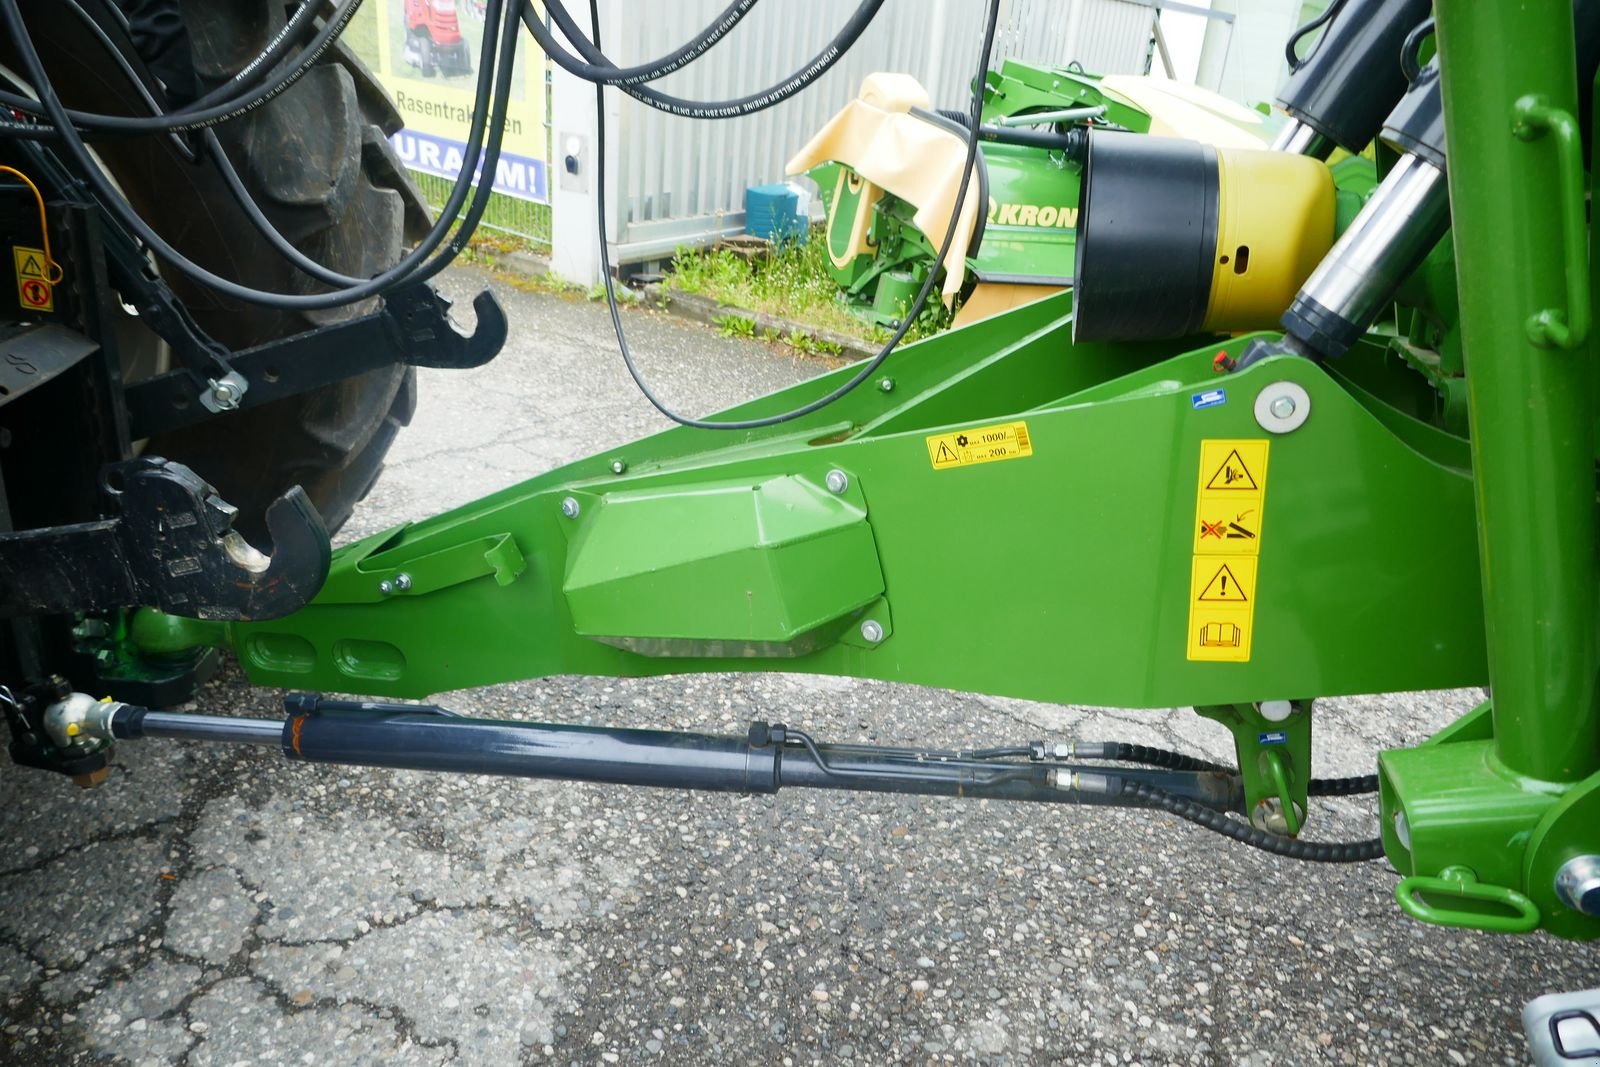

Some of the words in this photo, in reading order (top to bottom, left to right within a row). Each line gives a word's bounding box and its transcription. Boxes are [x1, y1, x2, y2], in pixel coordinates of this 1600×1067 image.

[801, 46, 838, 83] HYDRAULIK
[768, 78, 802, 102] MUELLER
[396, 90, 523, 136] Rasentrakoen
[394, 132, 536, 193] URAM!
[998, 203, 1078, 228] KRON
[988, 448, 1006, 457] 200
